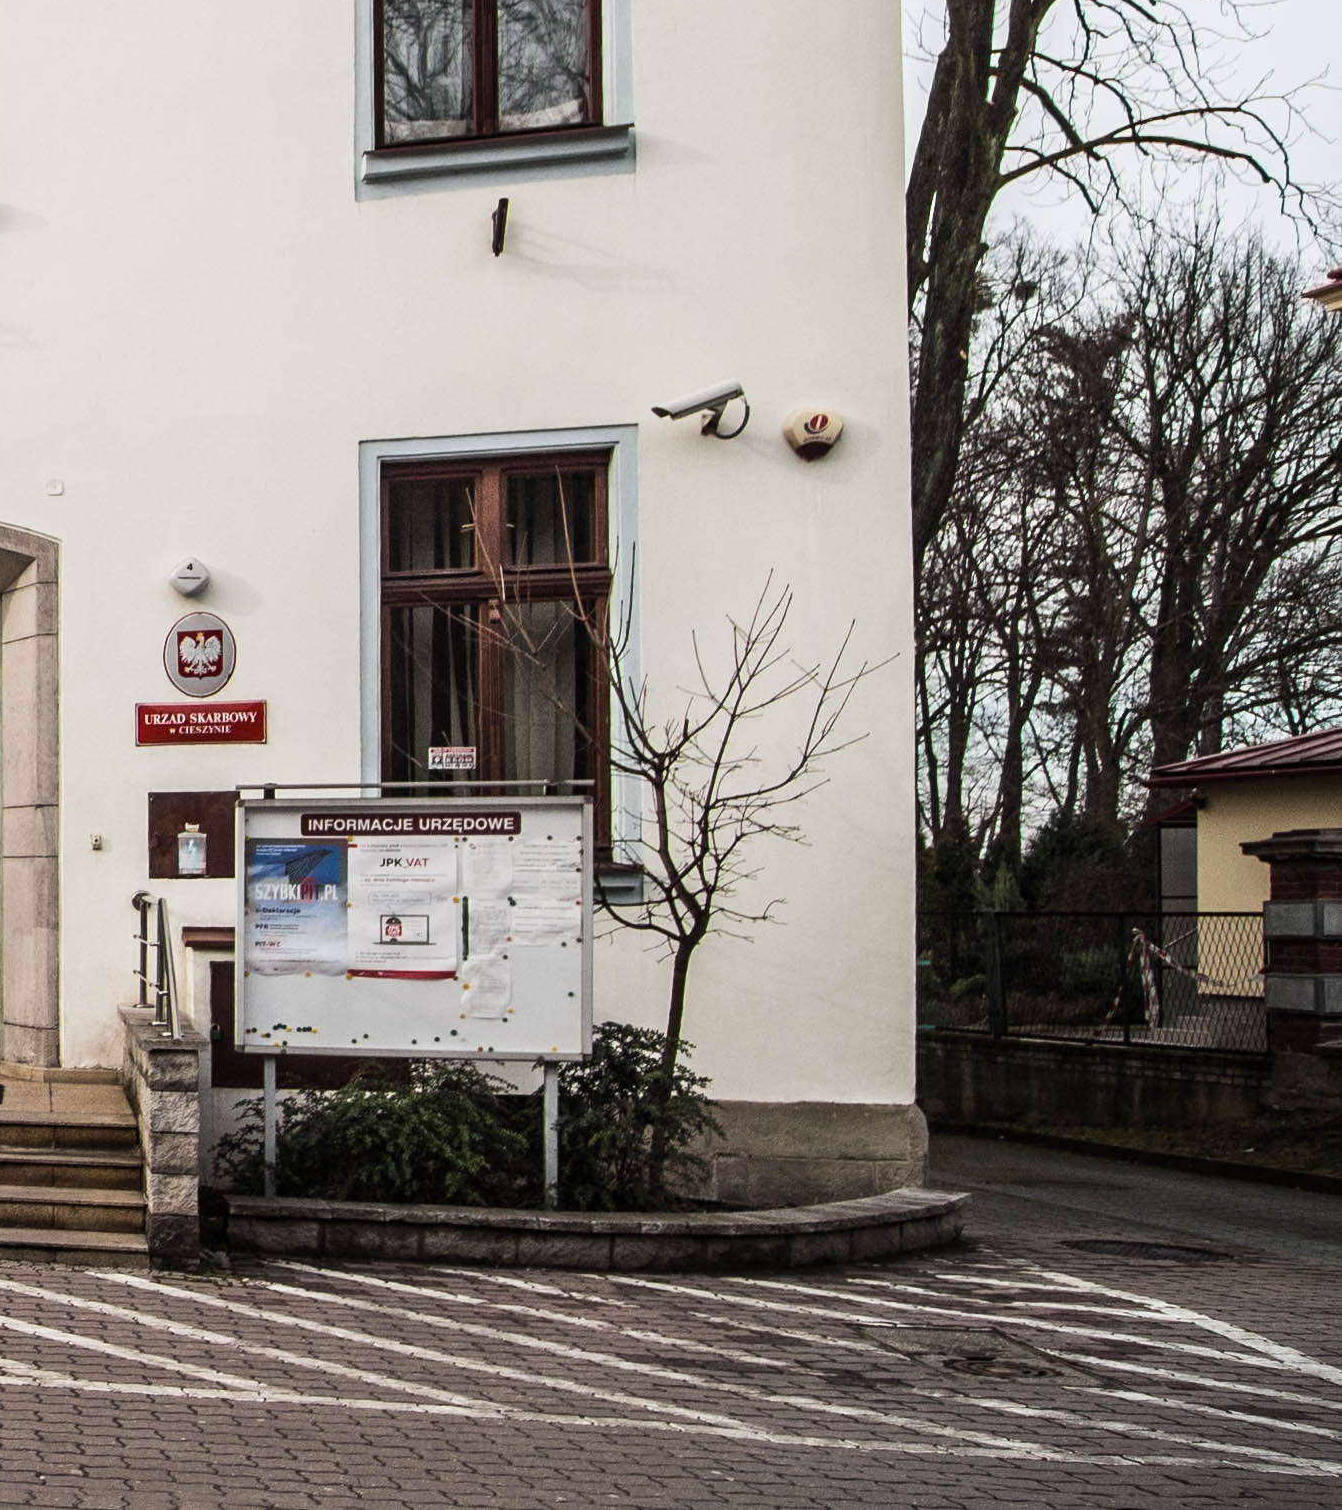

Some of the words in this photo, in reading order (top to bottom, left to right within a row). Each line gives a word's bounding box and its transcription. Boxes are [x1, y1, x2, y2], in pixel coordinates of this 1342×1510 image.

[189, 711, 258, 724] SKARBOWY
[178, 724, 233, 735] CIESZYNIE
[308, 818, 414, 831] INFORMACJE
[419, 817, 514, 833] URZĘDOWE
